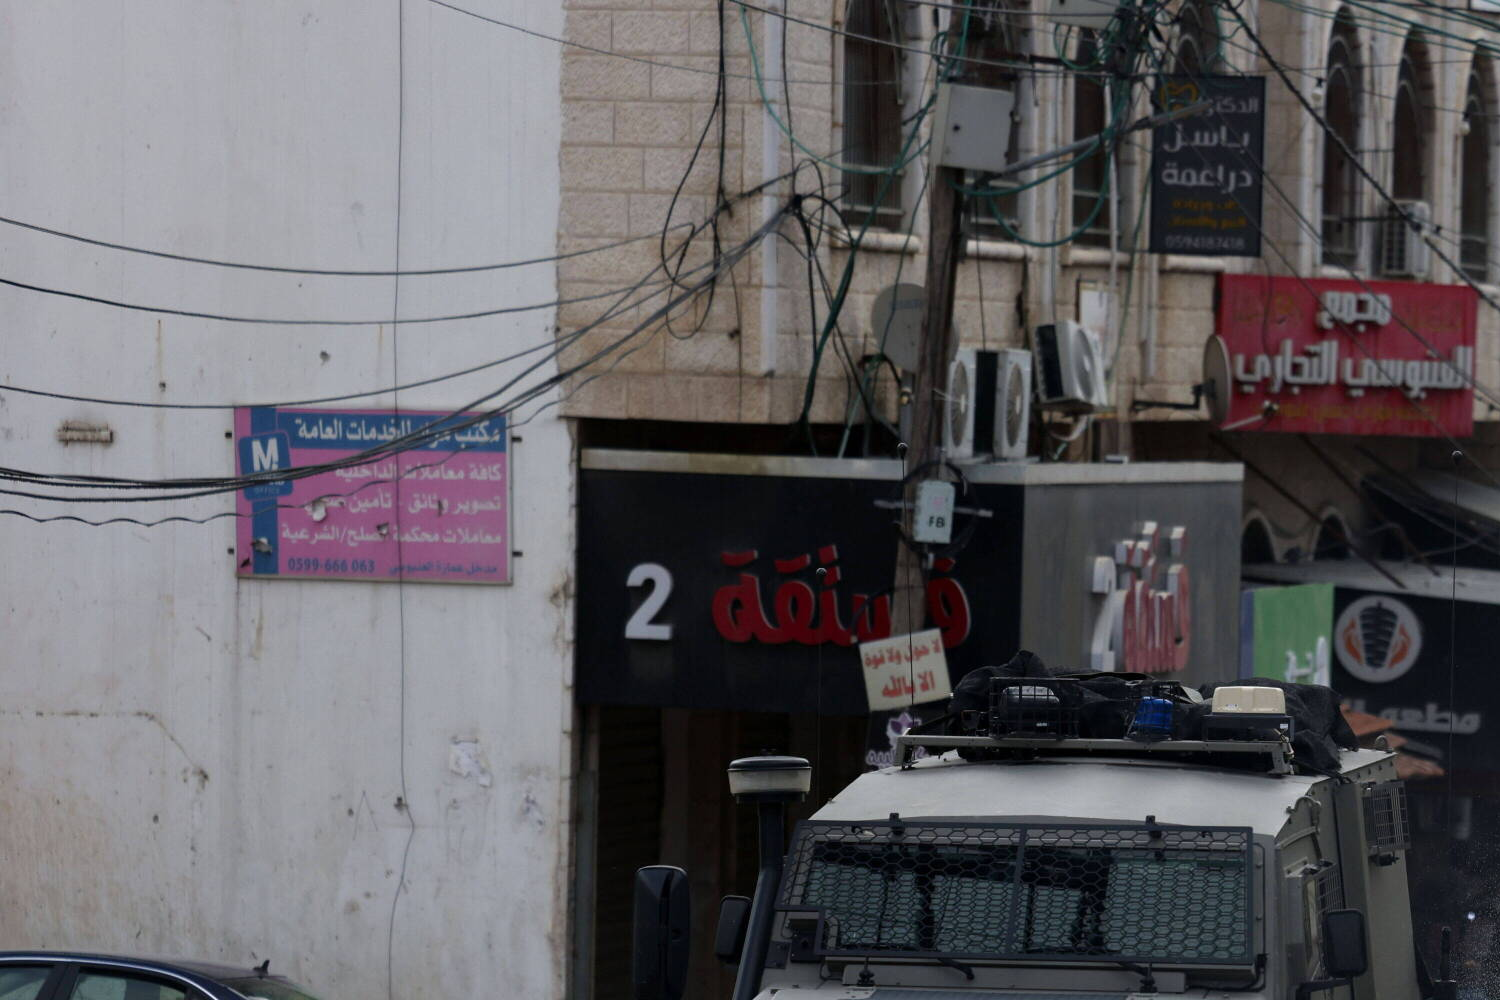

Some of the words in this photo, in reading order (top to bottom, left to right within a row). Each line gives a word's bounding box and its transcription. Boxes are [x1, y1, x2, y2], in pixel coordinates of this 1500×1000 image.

[1318, 290, 1391, 331] مجمع
[1234, 338, 1339, 396] التجاري
[297, 416, 343, 441] العامة
[469, 463, 502, 481] كافة
[452, 495, 501, 515] تصوير
[442, 527, 501, 545] معاملات
[624, 563, 673, 641] 2
